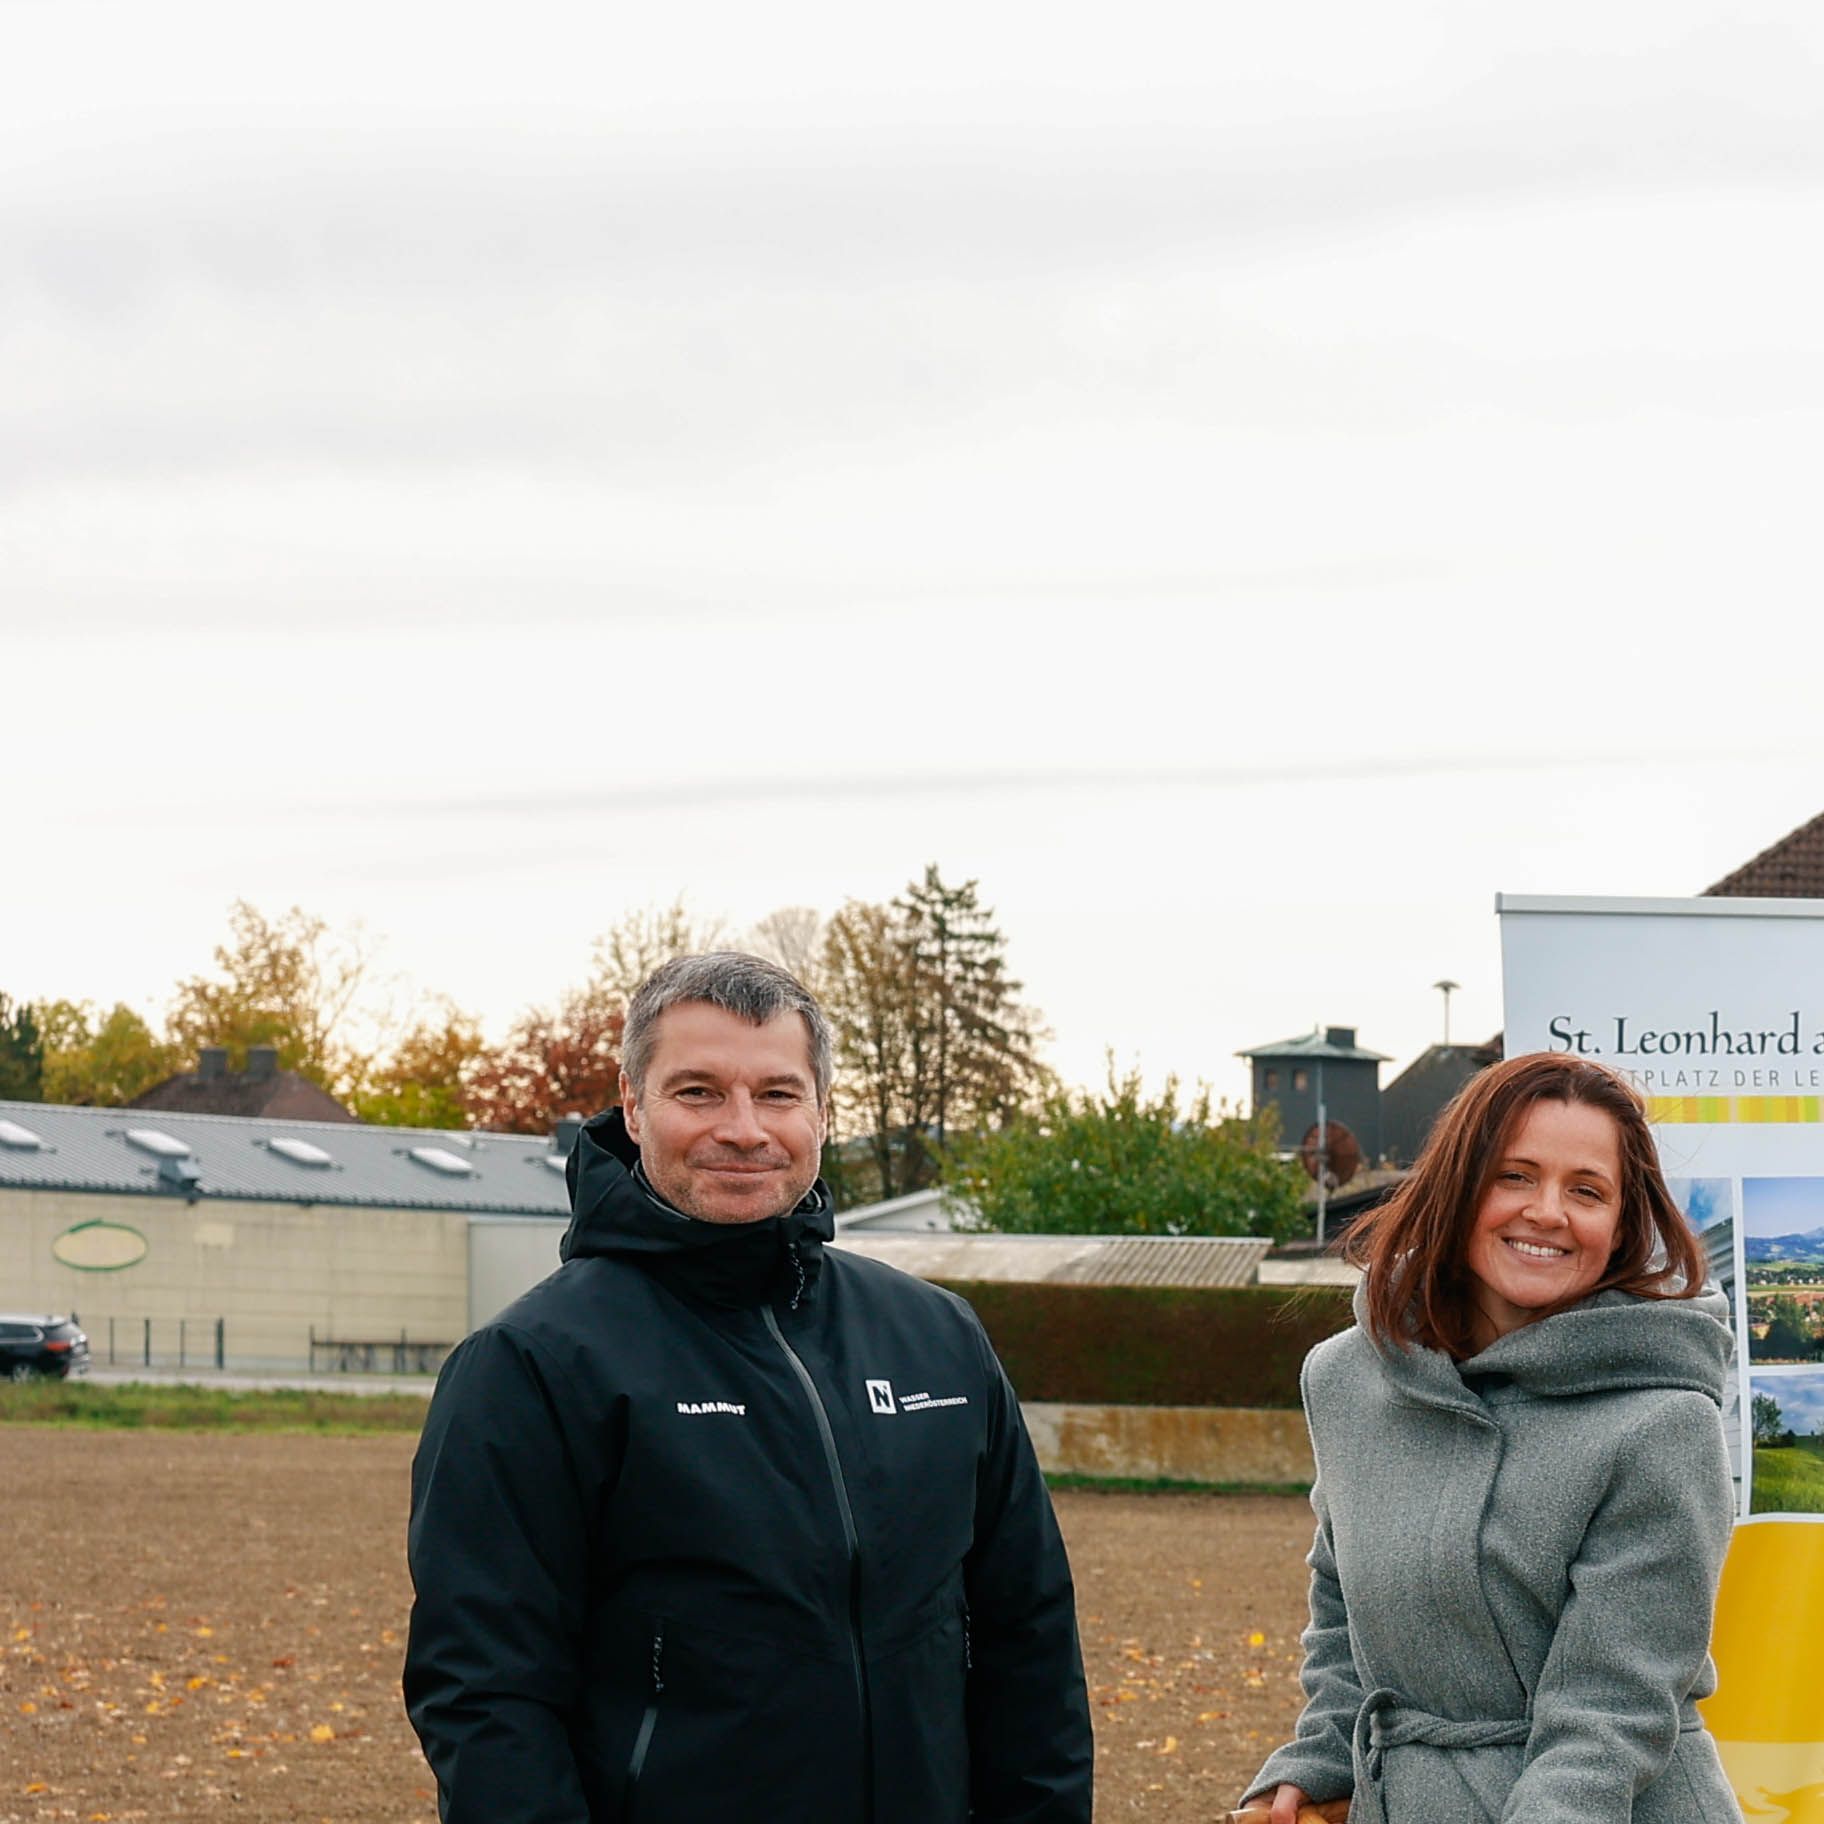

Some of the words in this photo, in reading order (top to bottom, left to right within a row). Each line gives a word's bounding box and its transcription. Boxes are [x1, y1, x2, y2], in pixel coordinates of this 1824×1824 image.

[1549, 1016, 1600, 1054] St.
[1613, 1011, 1800, 1056] Leonhard
[1622, 1070, 1720, 1087] TPLATZ
[1734, 1070, 1780, 1087] DER
[899, 1392, 930, 1404] WASSER
[677, 1401, 746, 1416] MAMMUT
